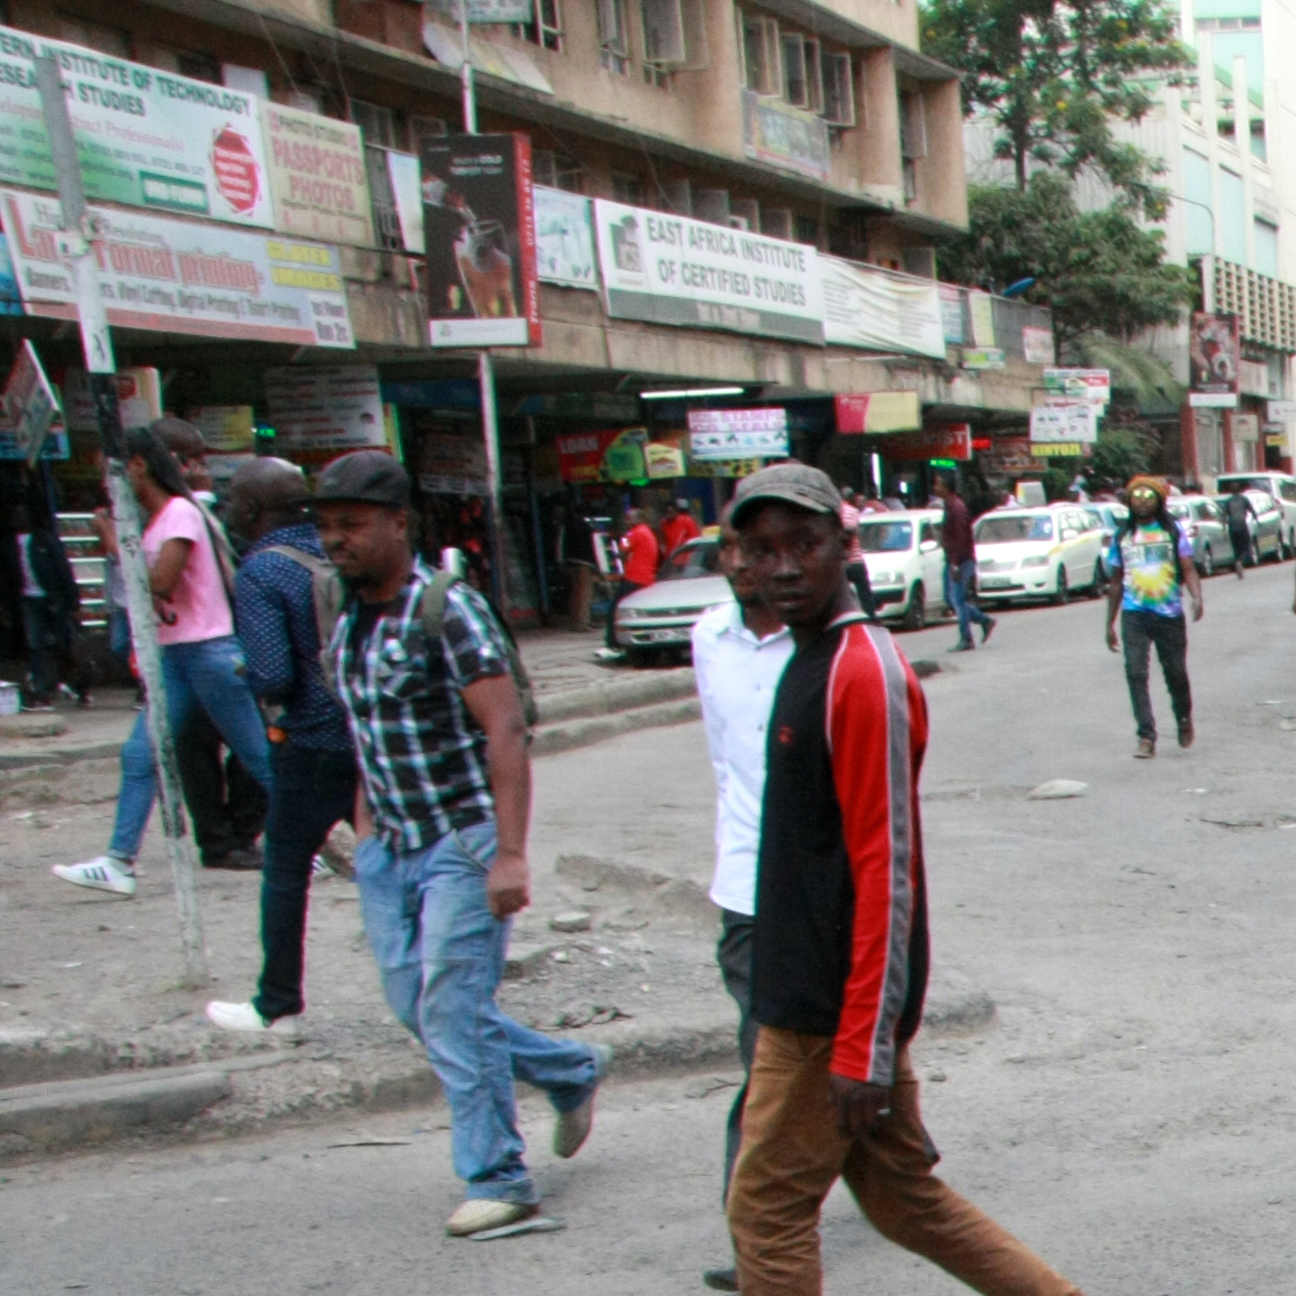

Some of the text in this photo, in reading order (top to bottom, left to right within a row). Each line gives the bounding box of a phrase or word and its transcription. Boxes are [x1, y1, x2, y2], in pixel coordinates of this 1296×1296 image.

[77, 82, 146, 117] STUDIES
[132, 69, 151, 89] OF
[155, 75, 250, 116] TECHNOLOGY
[272, 137, 364, 185] PASSPORTS
[290, 175, 355, 211] PHOTOS
[646, 217, 807, 273] EAST AFRICA INSTITUTE
[658, 259, 806, 307] OF CERTIFIED STUDIES
